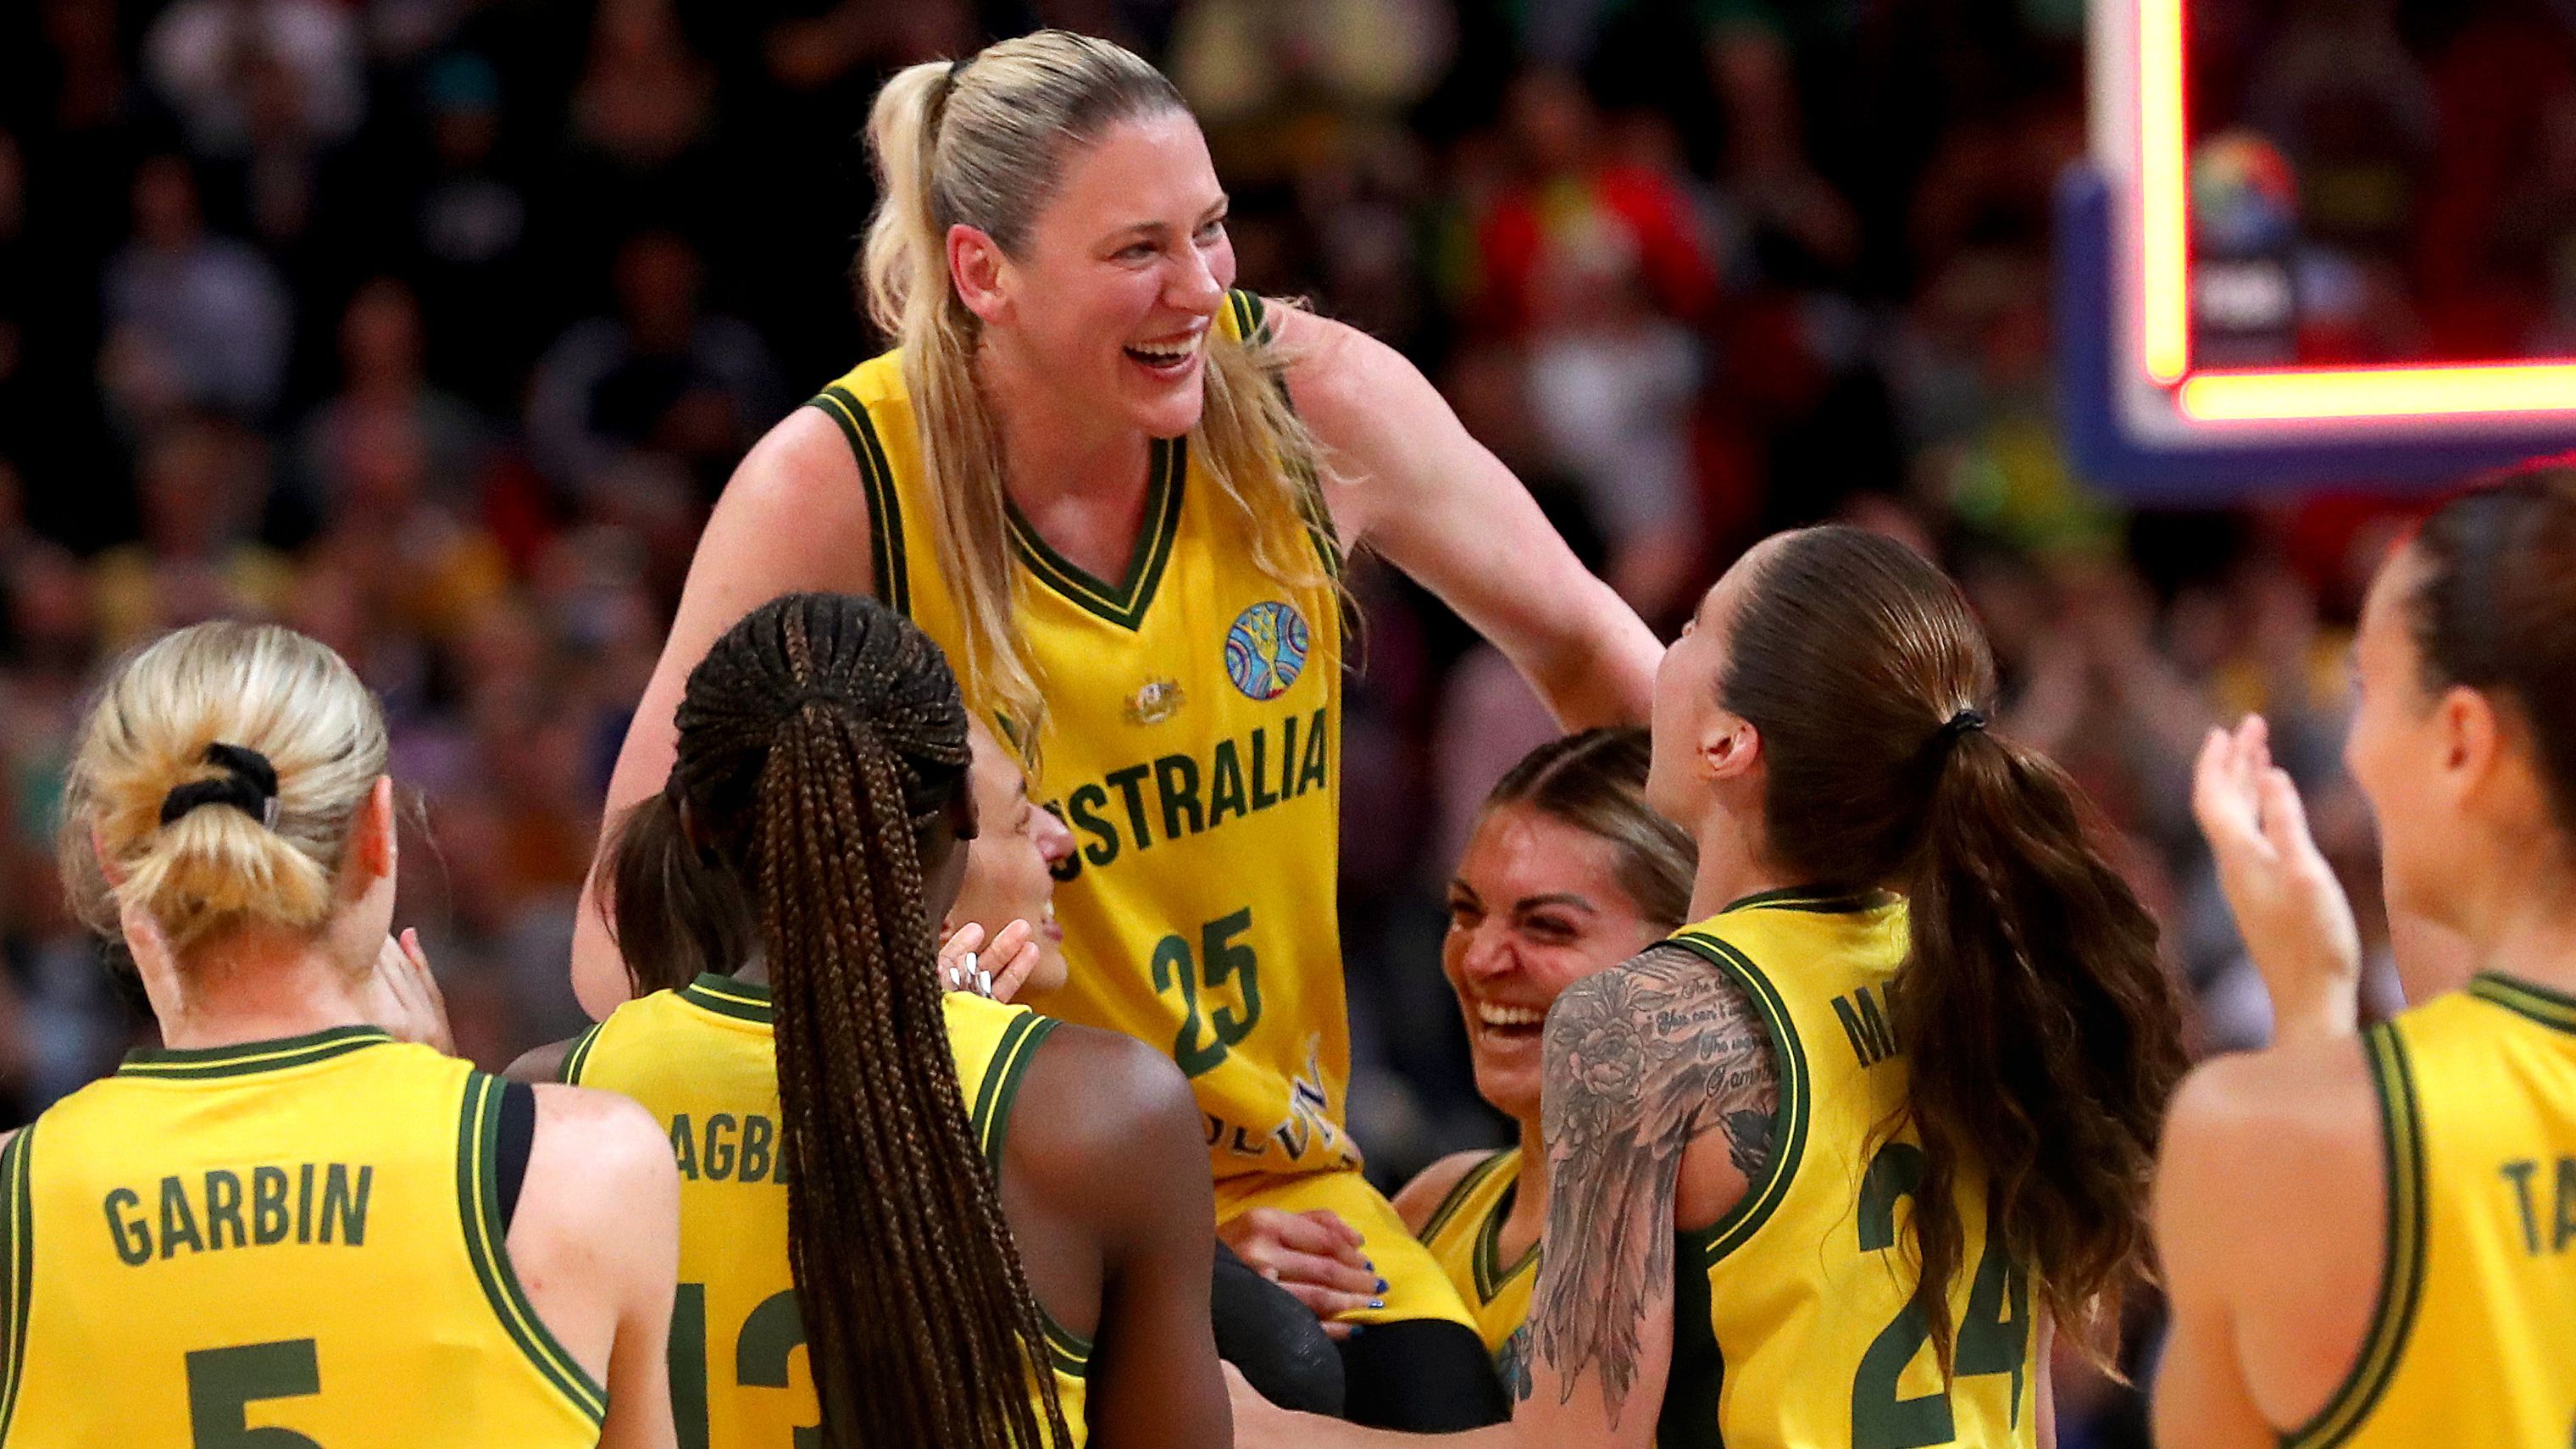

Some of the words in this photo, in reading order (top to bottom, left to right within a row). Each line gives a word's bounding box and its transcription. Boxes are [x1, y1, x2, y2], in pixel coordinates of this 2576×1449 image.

[1152, 906, 1263, 1080] 25
[103, 1163, 374, 1268] GARBIN
[1851, 1141, 2031, 1449] 24
